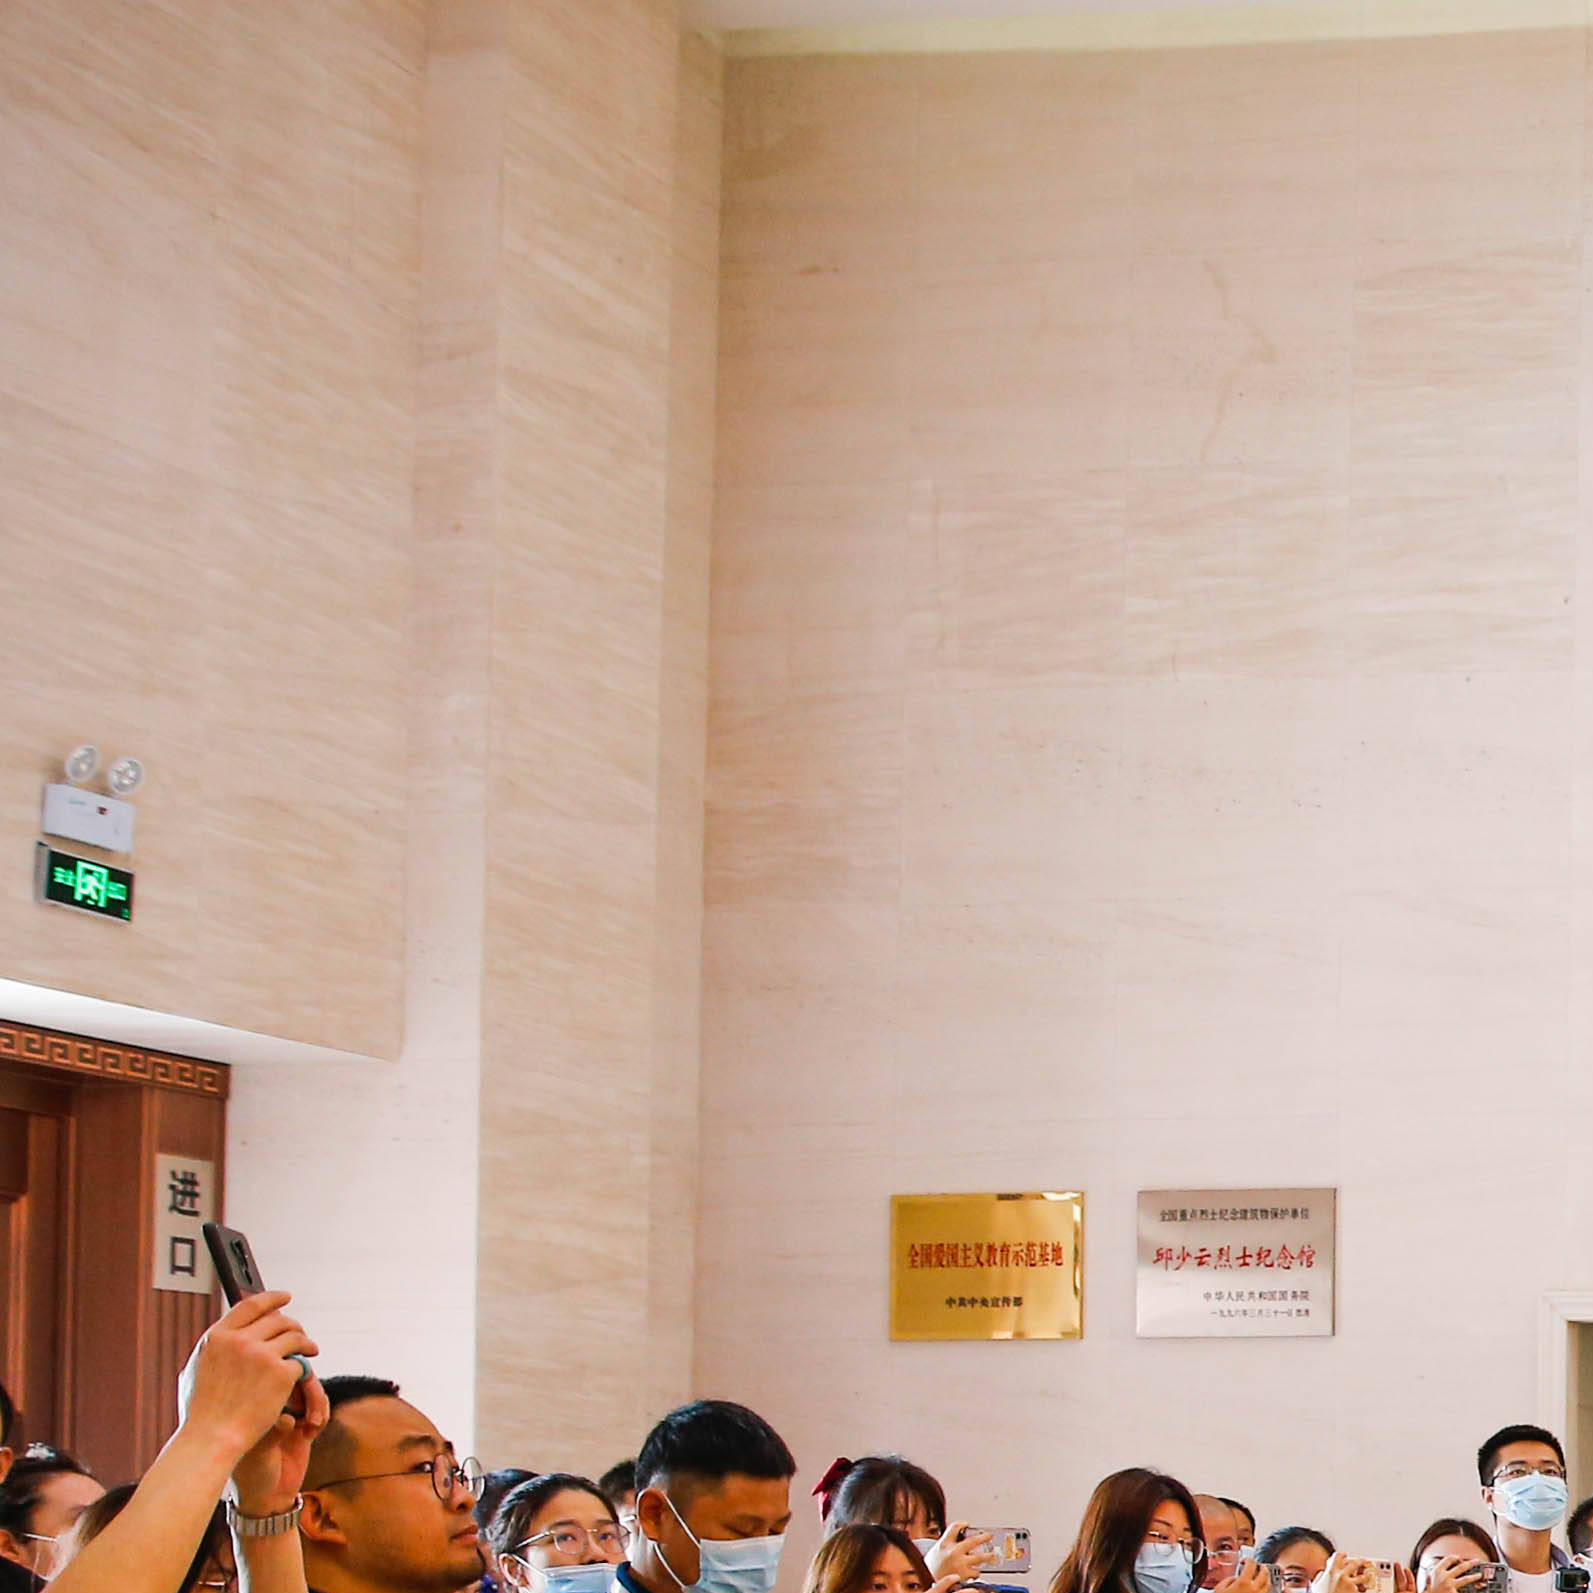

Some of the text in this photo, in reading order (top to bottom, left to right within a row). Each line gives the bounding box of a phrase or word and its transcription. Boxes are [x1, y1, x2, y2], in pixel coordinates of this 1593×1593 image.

[168, 1170, 200, 1277] 进口
[1153, 1243, 1317, 1272] 邱少云烈士纪念馆
